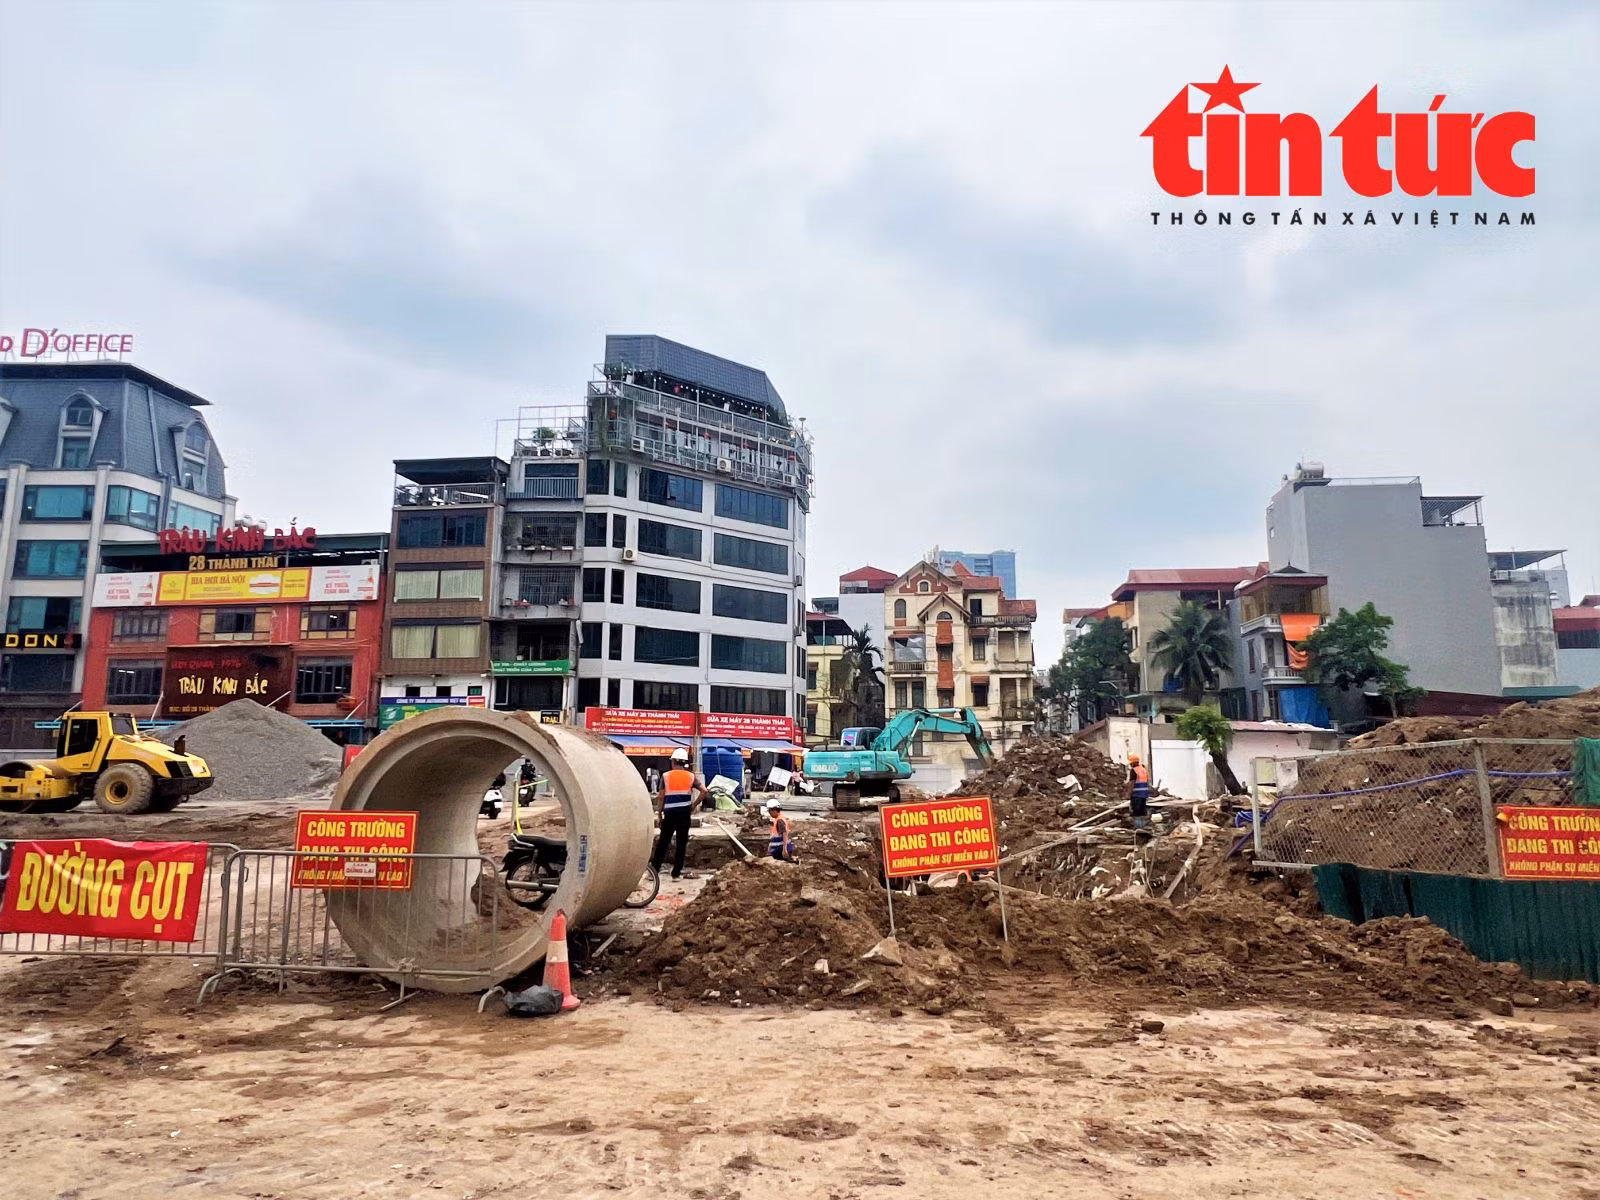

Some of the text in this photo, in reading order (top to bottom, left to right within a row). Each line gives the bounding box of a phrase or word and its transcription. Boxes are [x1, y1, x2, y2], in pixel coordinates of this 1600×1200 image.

[273, 516, 316, 551] BẮC
[188, 555, 206, 571] 28
[5, 633, 58, 648] DON
[178, 672, 268, 695] TRÂU KINH BẮC
[891, 803, 983, 829] CÔNG TRƯỜNG
[1509, 811, 1549, 831] CÔNG
[307, 818, 406, 838] CÔNG TRƯỜNG
[890, 826, 990, 852] ĐANG THI CÔNG
[1506, 836, 1600, 855] ĐANG THI CÔ
[892, 856, 918, 869] KHÔNG
[1509, 859, 1538, 871] KHÔNG
[15, 840, 195, 934] ĐƯỜNG CỤT
